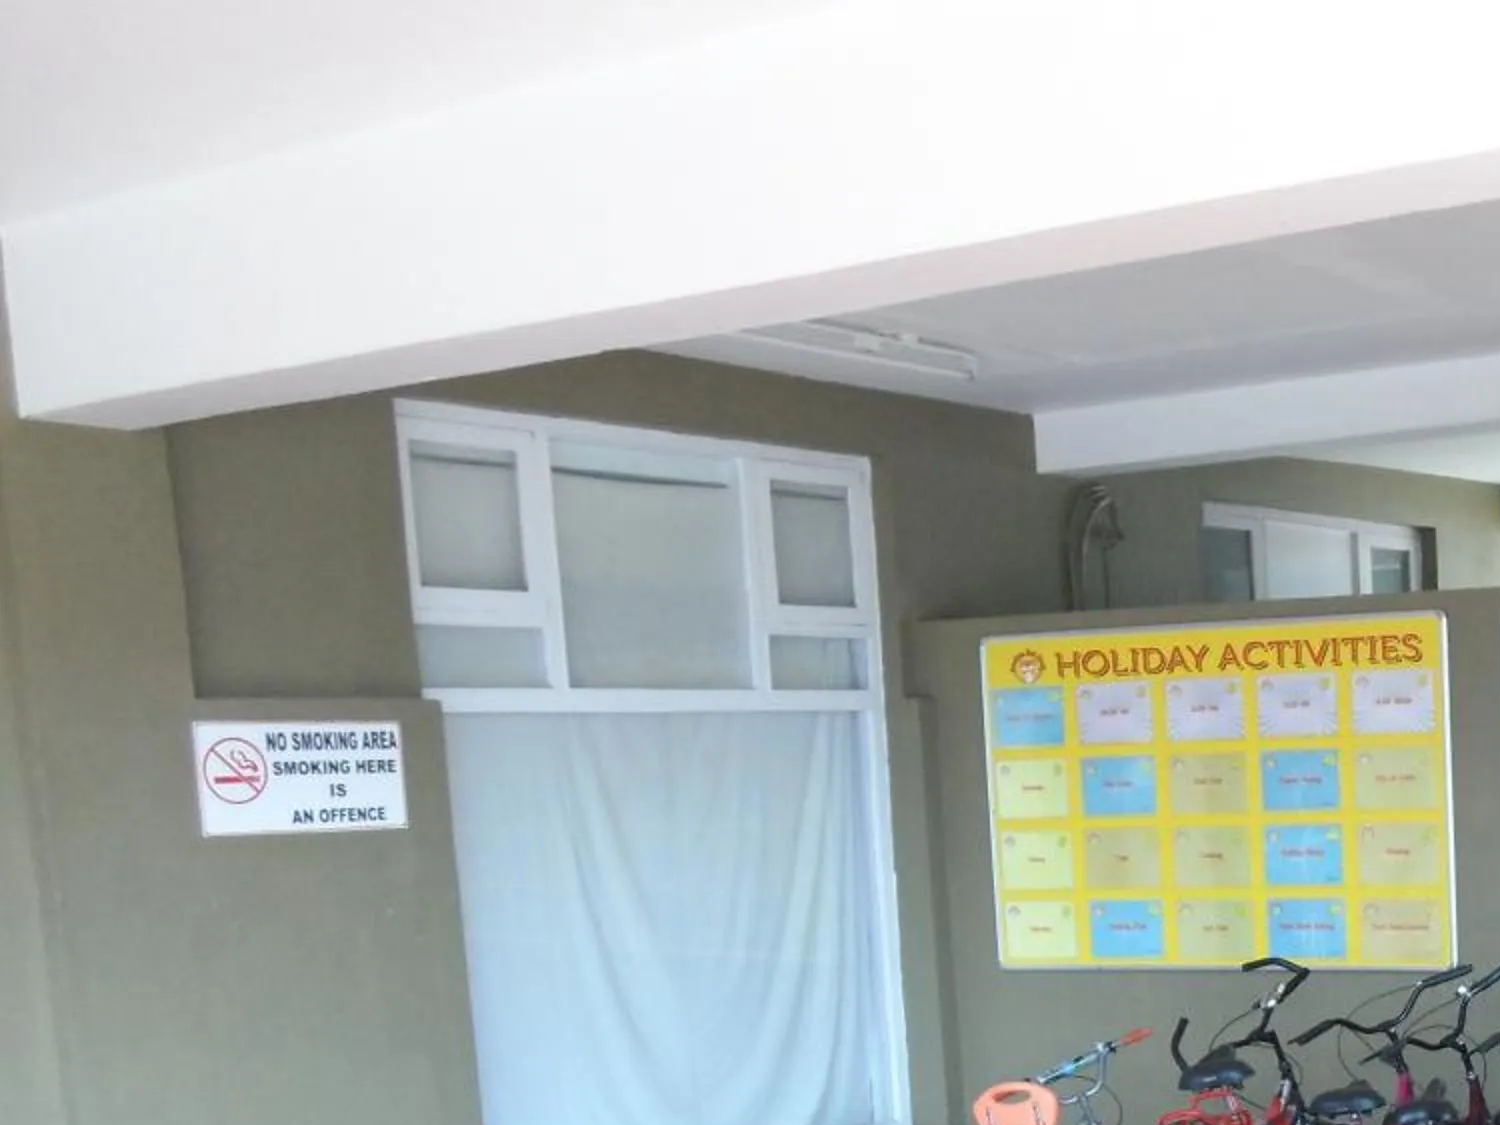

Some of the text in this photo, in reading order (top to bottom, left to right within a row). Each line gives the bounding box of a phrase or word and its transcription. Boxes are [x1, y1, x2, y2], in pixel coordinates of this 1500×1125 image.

[1055, 633, 1424, 679] HOLIDAY ACTIVITIES
[265, 731, 397, 752] NO SMOKING AREA
[272, 758, 397, 776] SMOKING HERE
[329, 783, 348, 797] IS
[292, 807, 386, 824] AN OFFENCE
